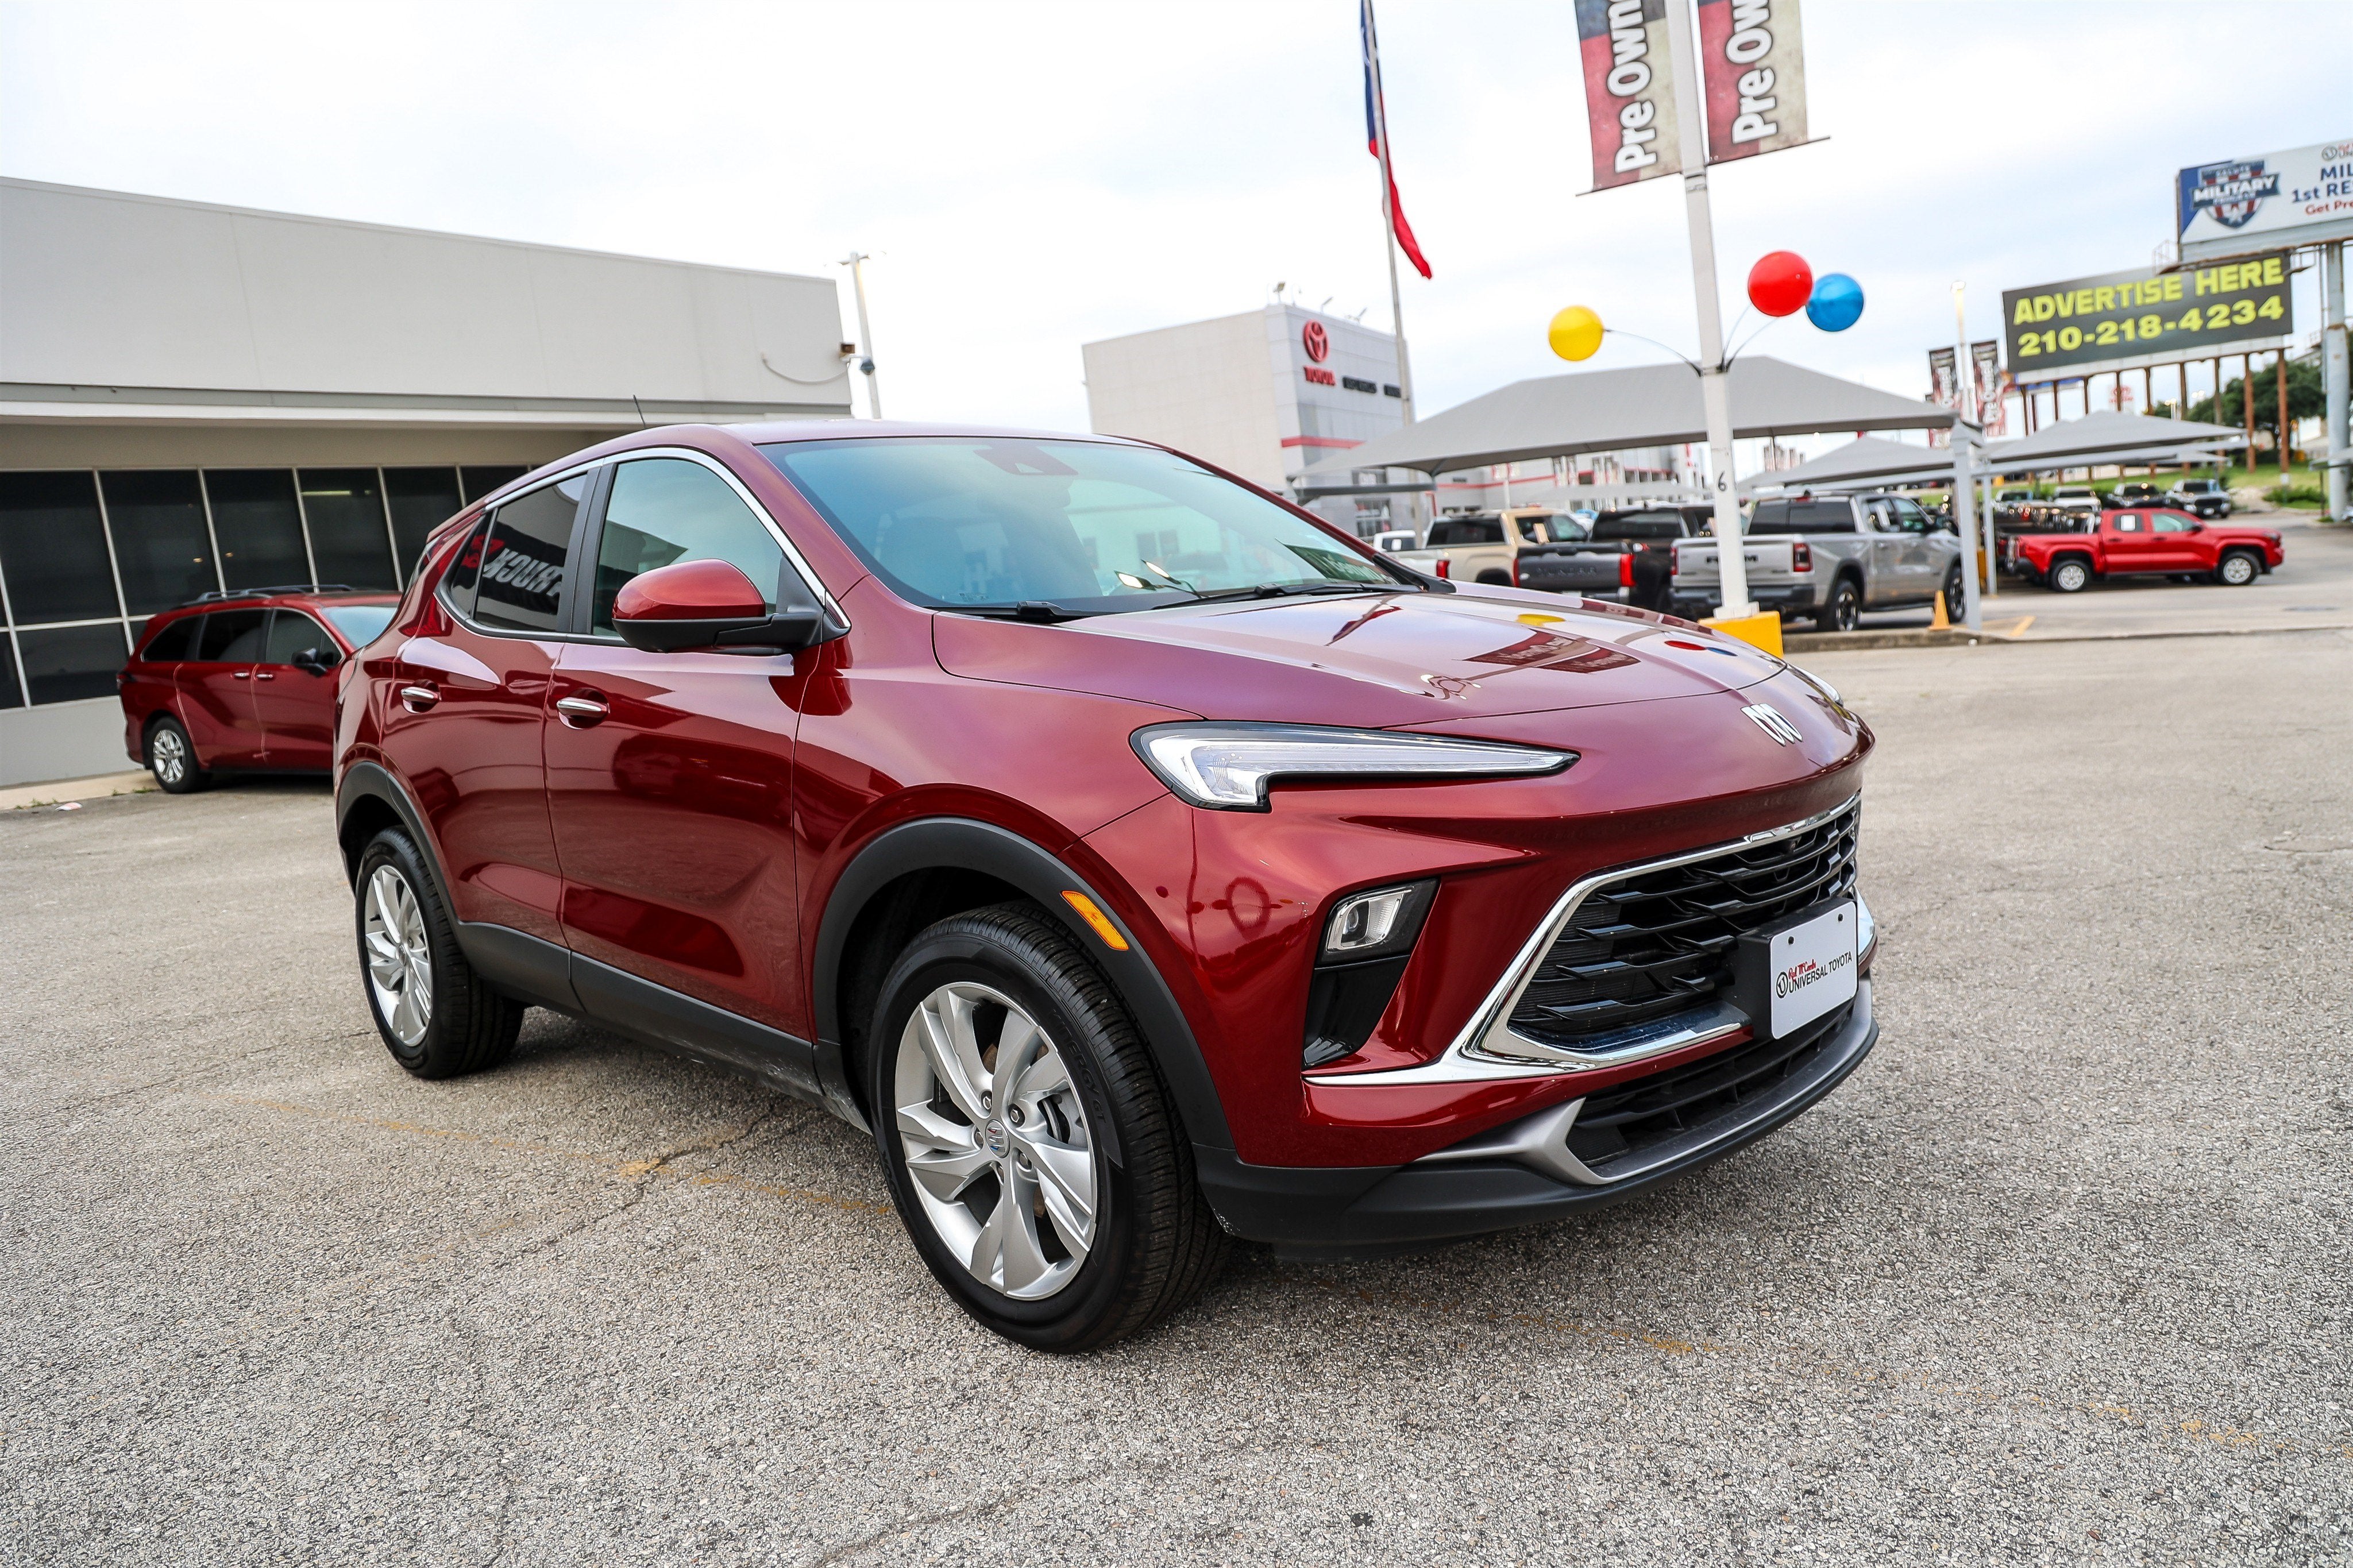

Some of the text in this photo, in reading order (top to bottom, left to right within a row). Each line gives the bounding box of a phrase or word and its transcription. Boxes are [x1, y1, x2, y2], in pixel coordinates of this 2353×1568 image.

[1607, 0, 1657, 173] Pre Own
[1732, 68, 1777, 144] Pre
[2193, 175, 2275, 202] MILITARY
[2293, 187, 2319, 203] 1st
[2305, 203, 2329, 216] Get
[2013, 257, 2284, 325] ADVERTISE HERE
[2018, 295, 2284, 357] 210-218-4234
[1718, 471, 1727, 492] 6
[1789, 951, 1853, 994] UNIVERSAL TOYOTA
